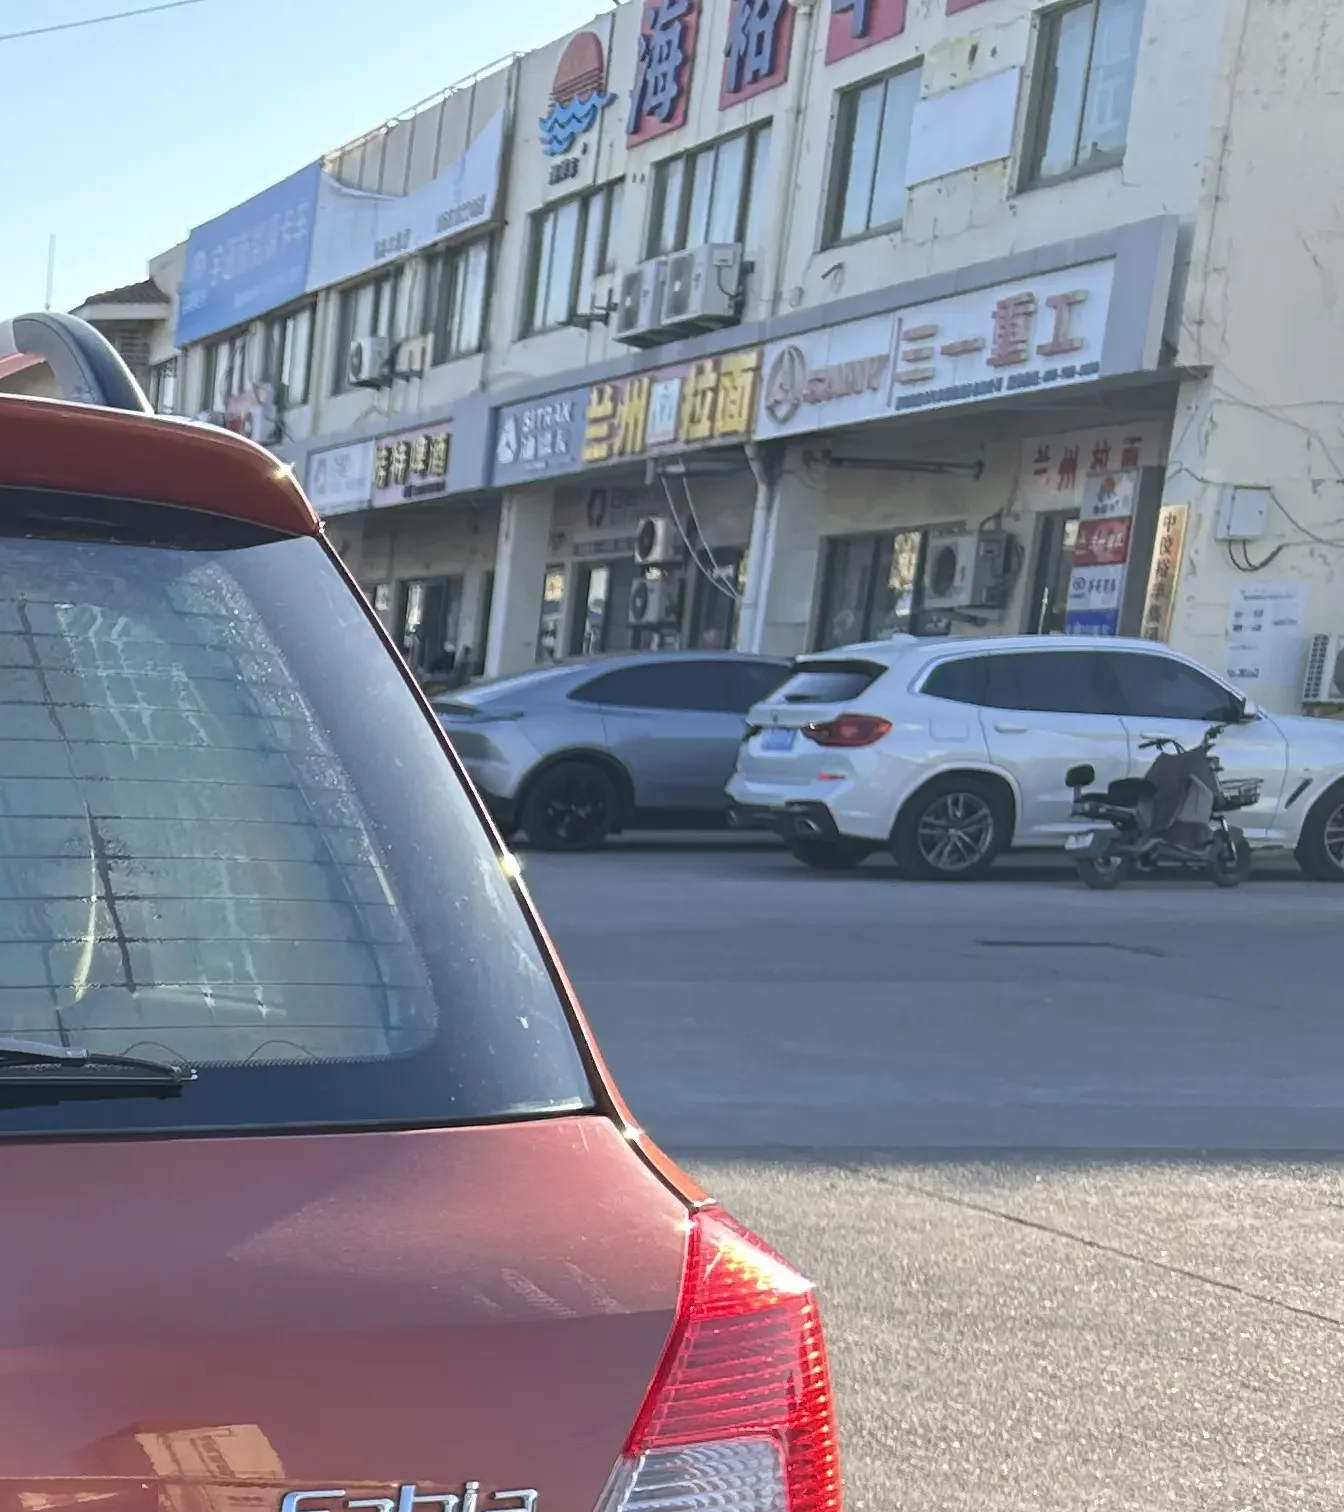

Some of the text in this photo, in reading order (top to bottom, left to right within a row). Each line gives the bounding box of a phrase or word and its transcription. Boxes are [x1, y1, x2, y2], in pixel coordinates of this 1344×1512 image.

[895, 290, 1090, 387] 三一重工
[582, 351, 758, 462] 兰州 拉面
